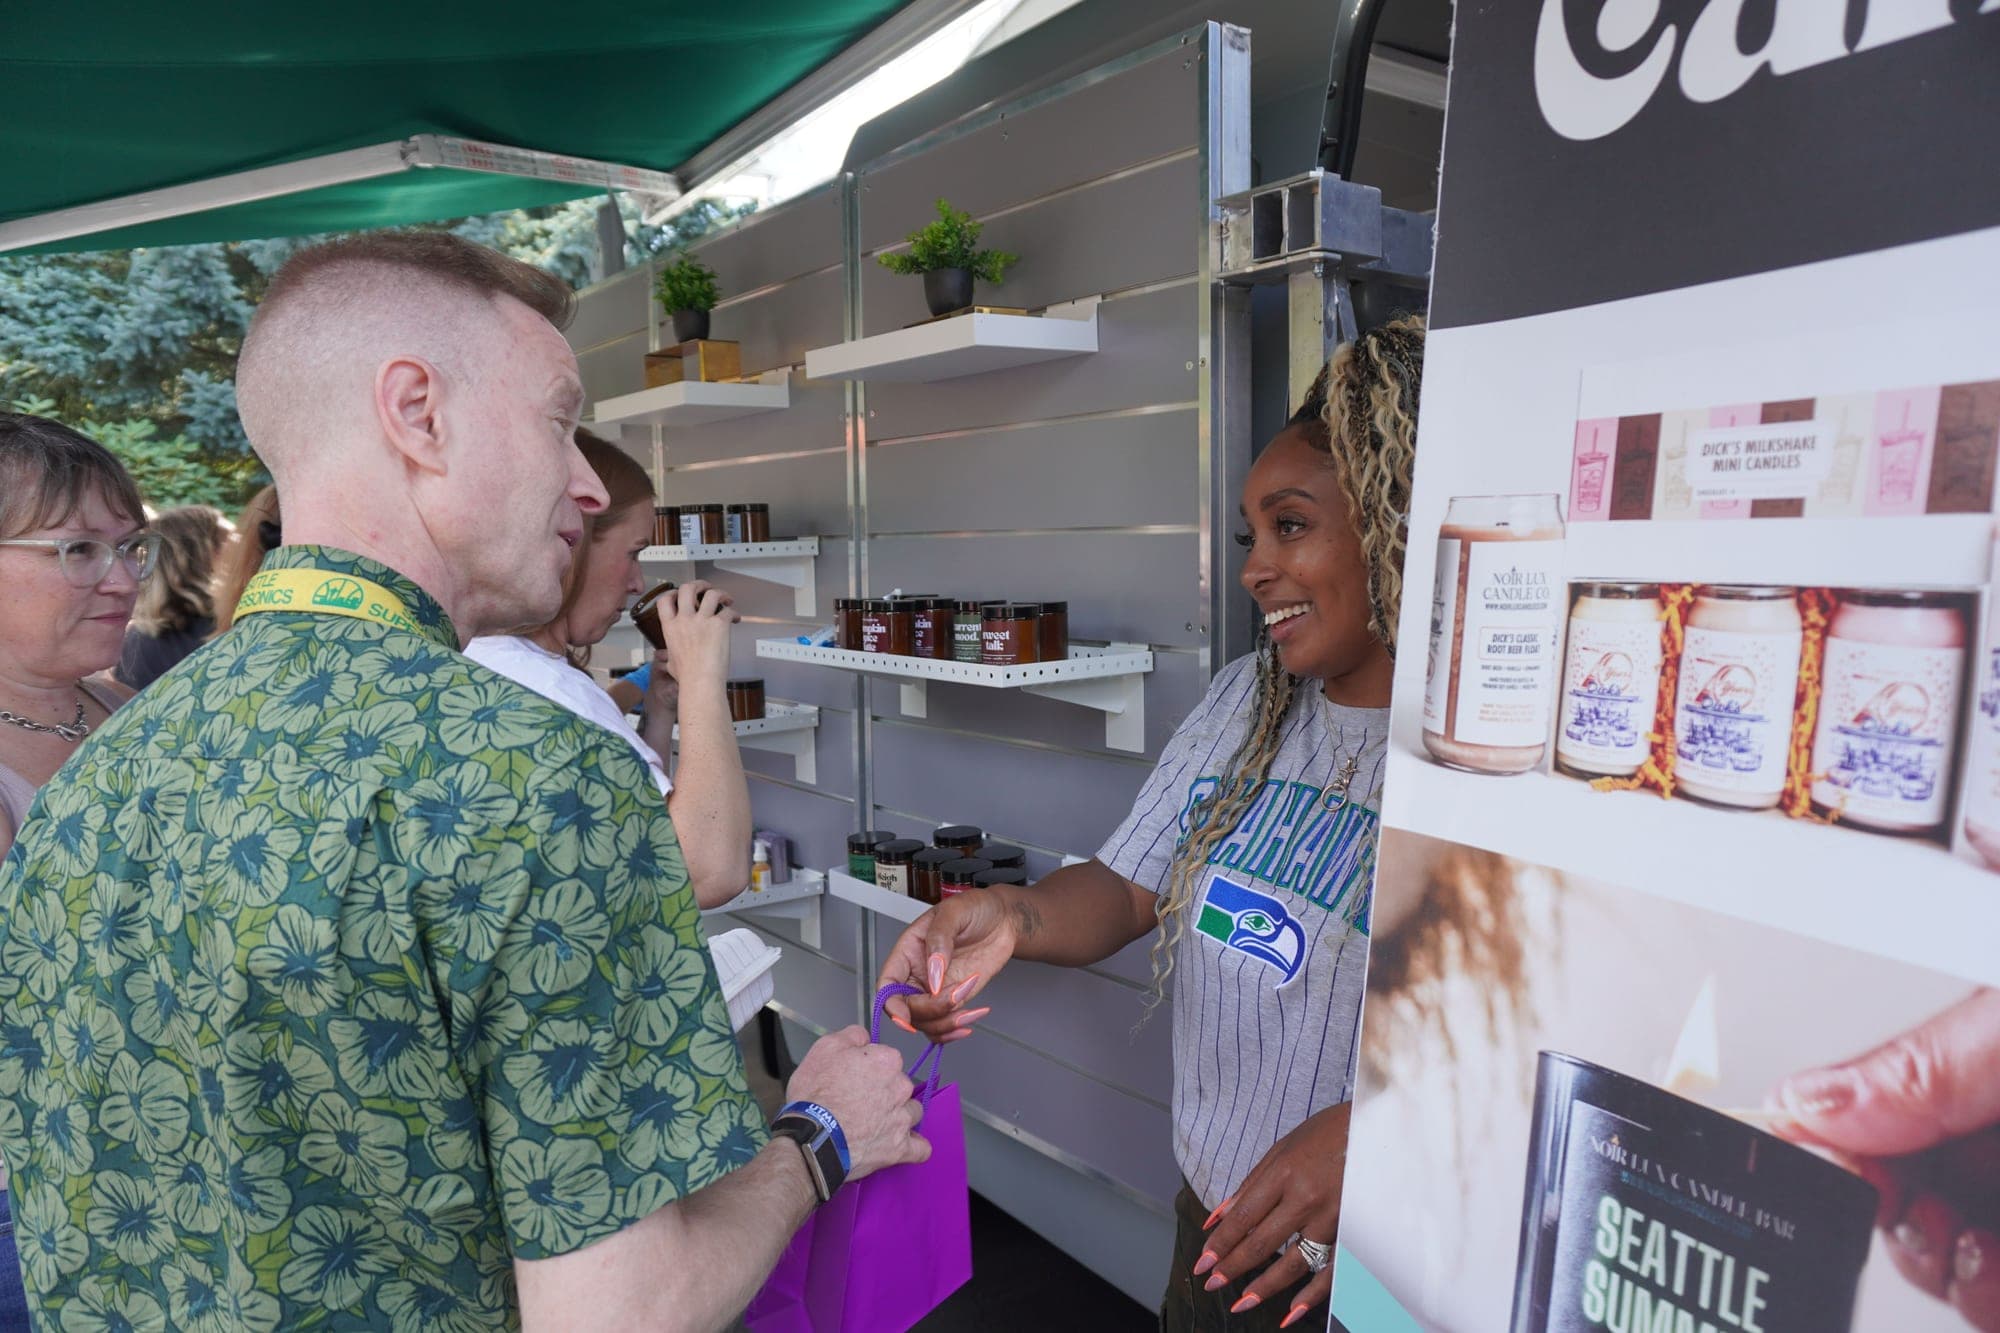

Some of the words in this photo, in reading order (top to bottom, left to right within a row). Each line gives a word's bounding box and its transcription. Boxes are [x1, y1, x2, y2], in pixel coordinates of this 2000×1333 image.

[1702, 440, 1742, 457] DICK'S
[1745, 435, 1817, 454] MILKSHAKE
[1712, 457, 1742, 473] MINI
[1746, 454, 1801, 471] CANDLES
[1482, 586, 1533, 601] CANDLE
[1487, 644, 1506, 654] ROOT
[1508, 645, 1523, 654] BEER
[1595, 1195, 1771, 1333] SEATTLE
